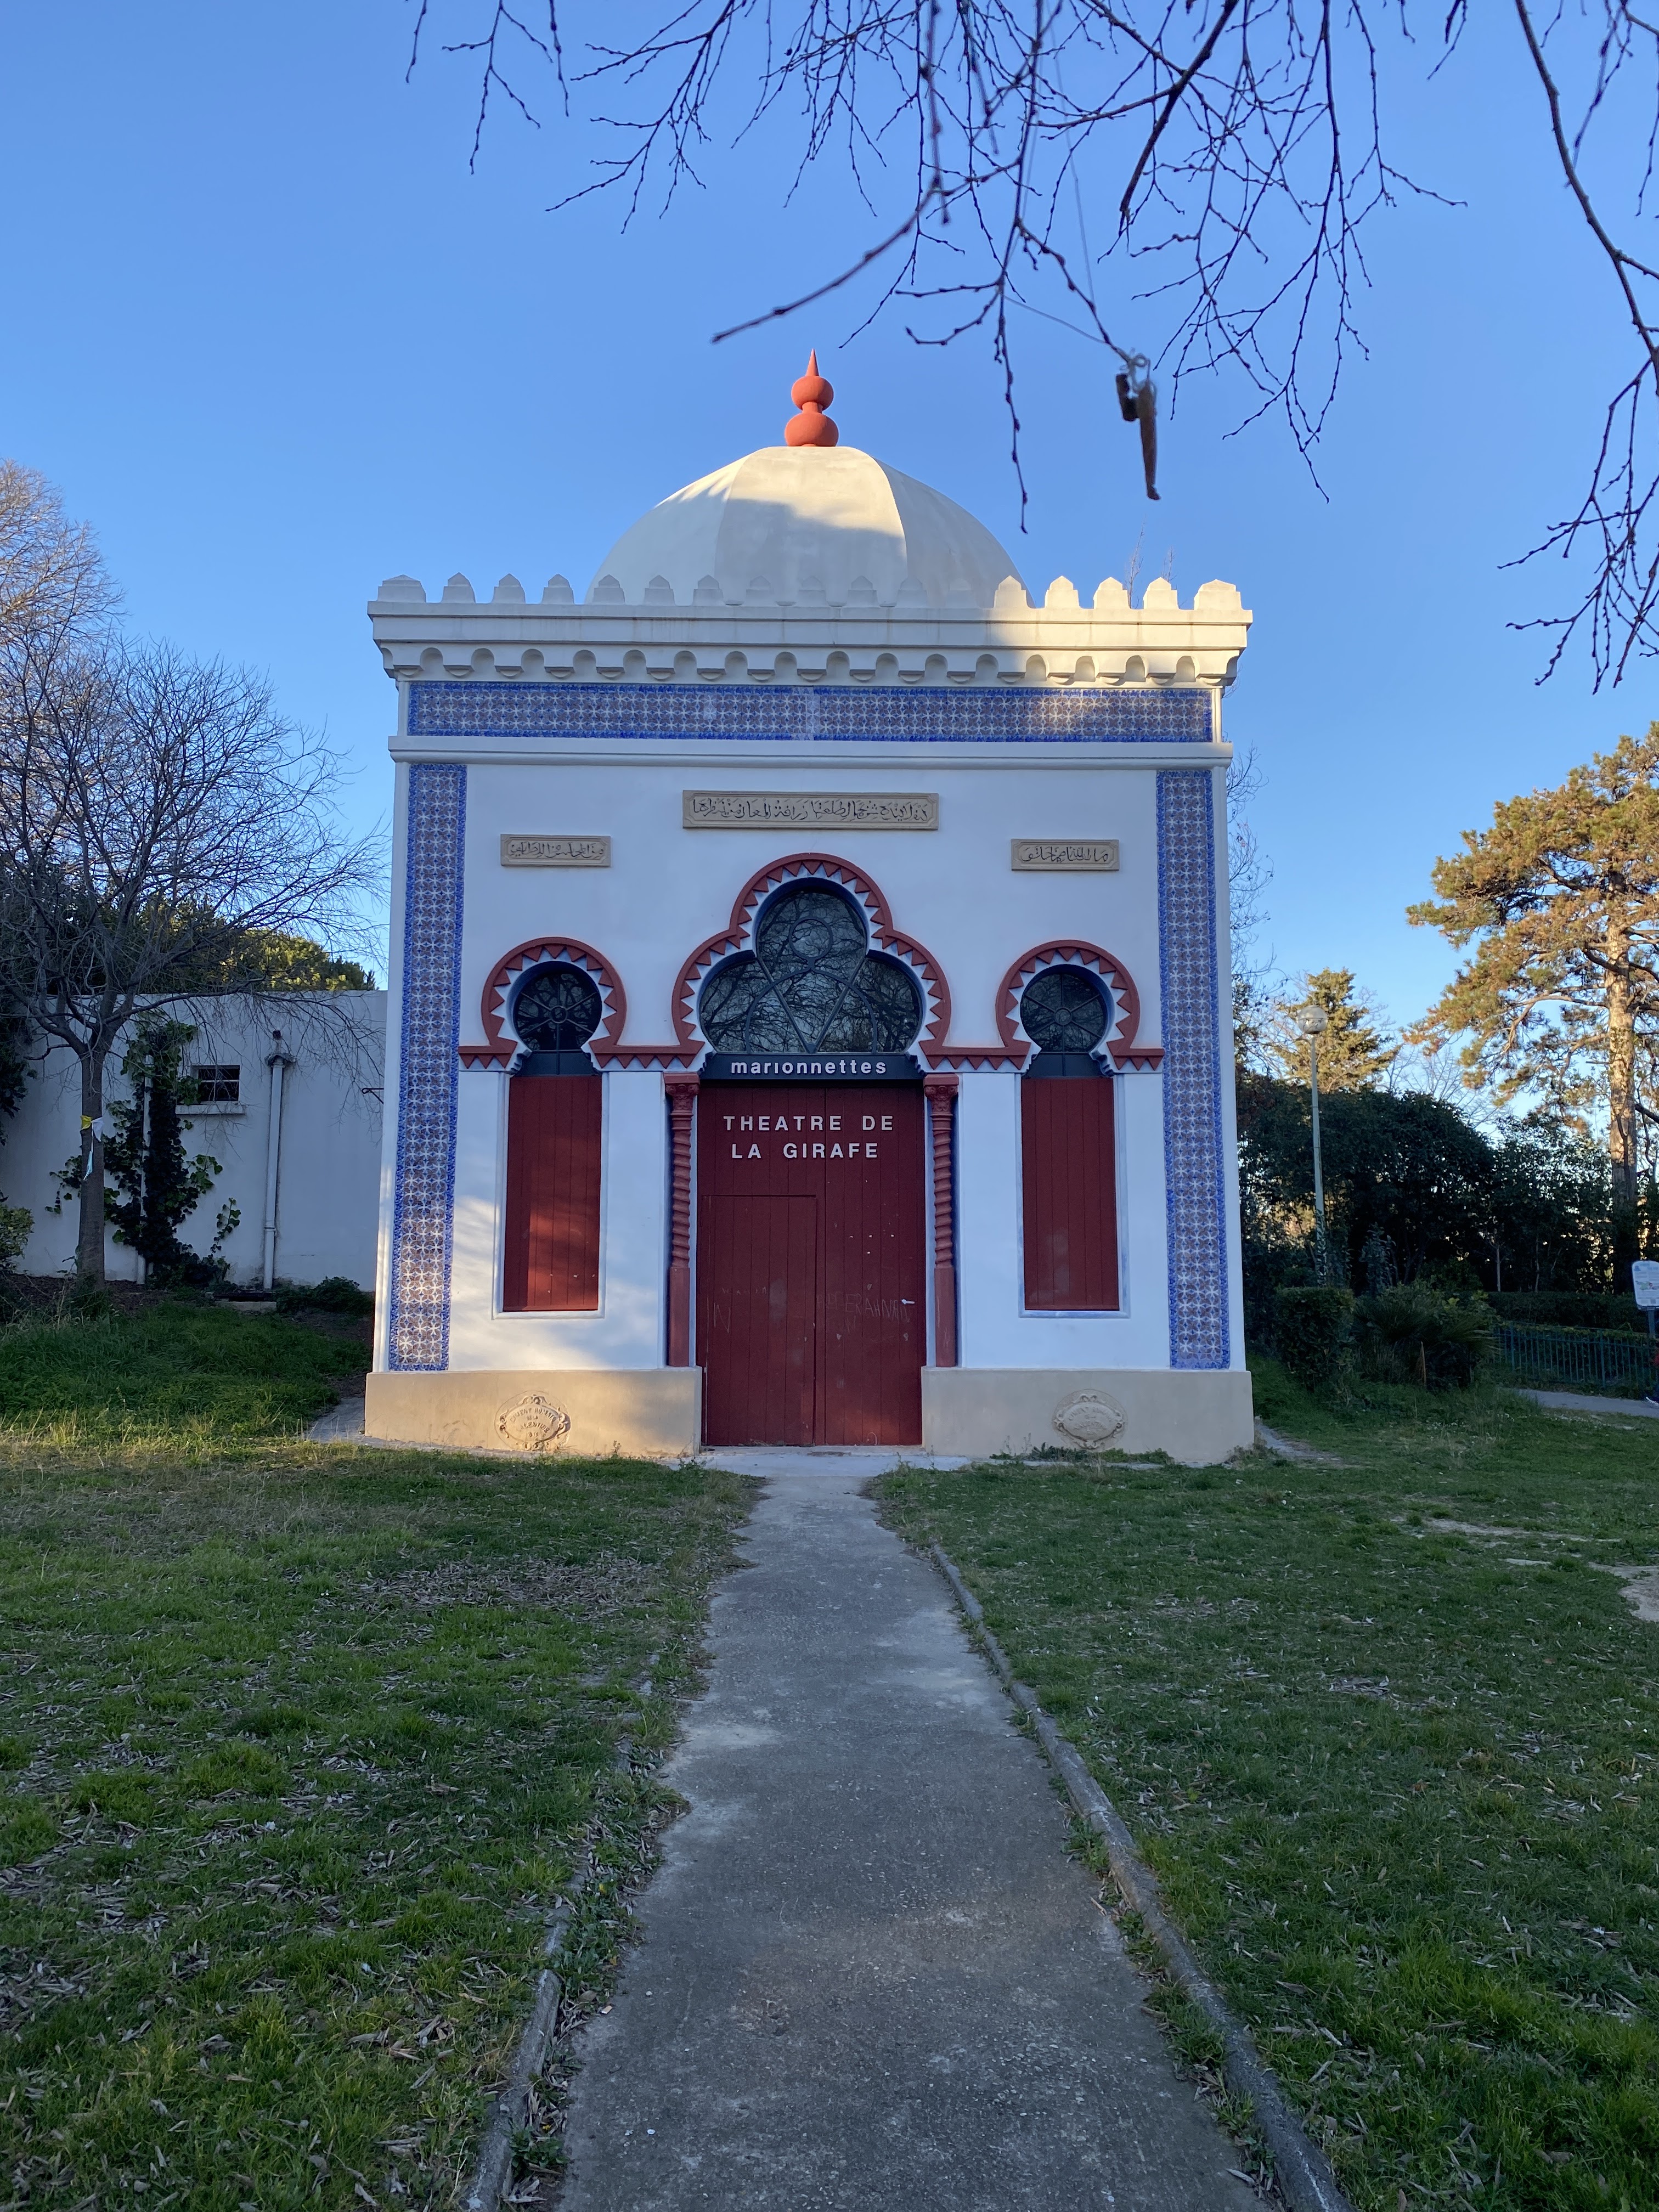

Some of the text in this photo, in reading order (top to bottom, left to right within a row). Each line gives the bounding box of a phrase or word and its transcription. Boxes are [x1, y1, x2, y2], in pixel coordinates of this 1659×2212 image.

[731, 1059, 887, 1074] marionnettes
[723, 1115, 893, 1131] THEATRE DE
[731, 1143, 878, 1159] LA GIRAFE
